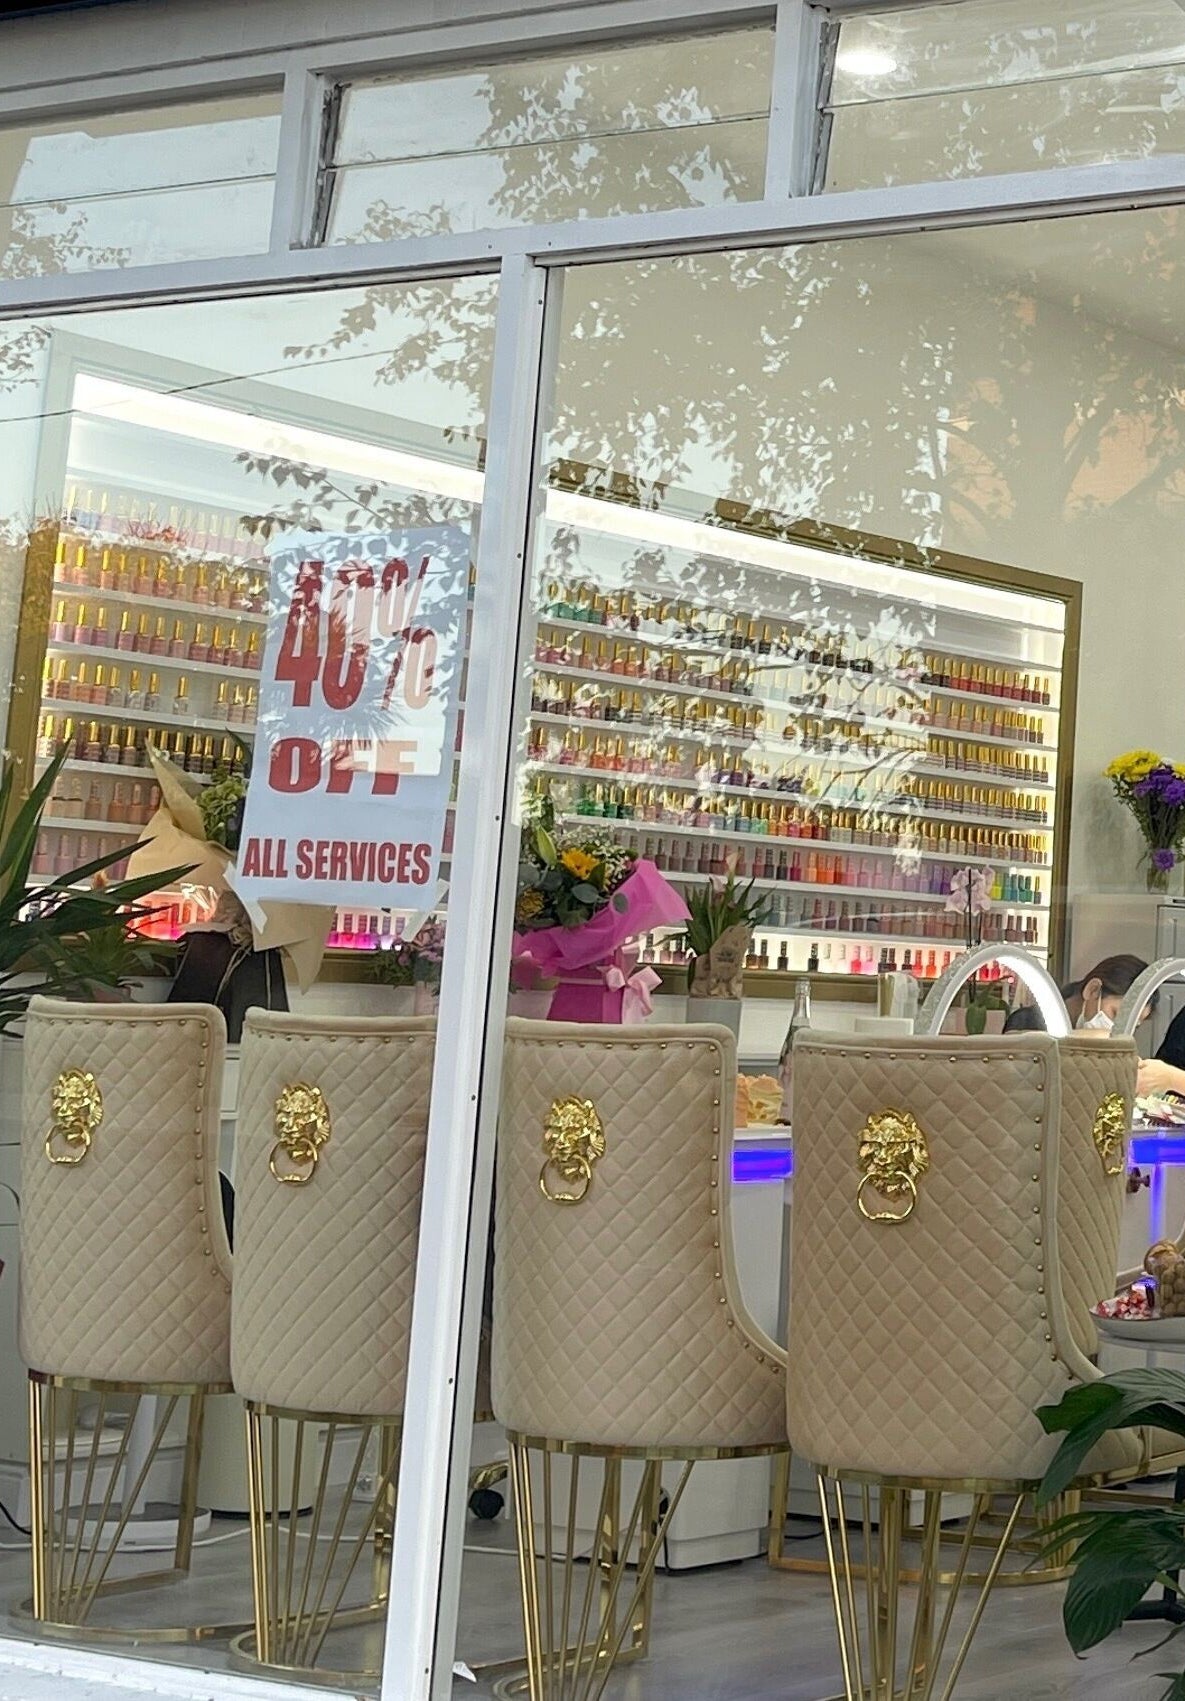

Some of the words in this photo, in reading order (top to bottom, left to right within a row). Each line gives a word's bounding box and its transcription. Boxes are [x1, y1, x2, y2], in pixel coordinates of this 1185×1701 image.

[274, 556, 437, 711] 40%
[267, 737, 418, 795] OFF
[241, 837, 288, 879] ALL
[295, 838, 432, 885] SERVICES
